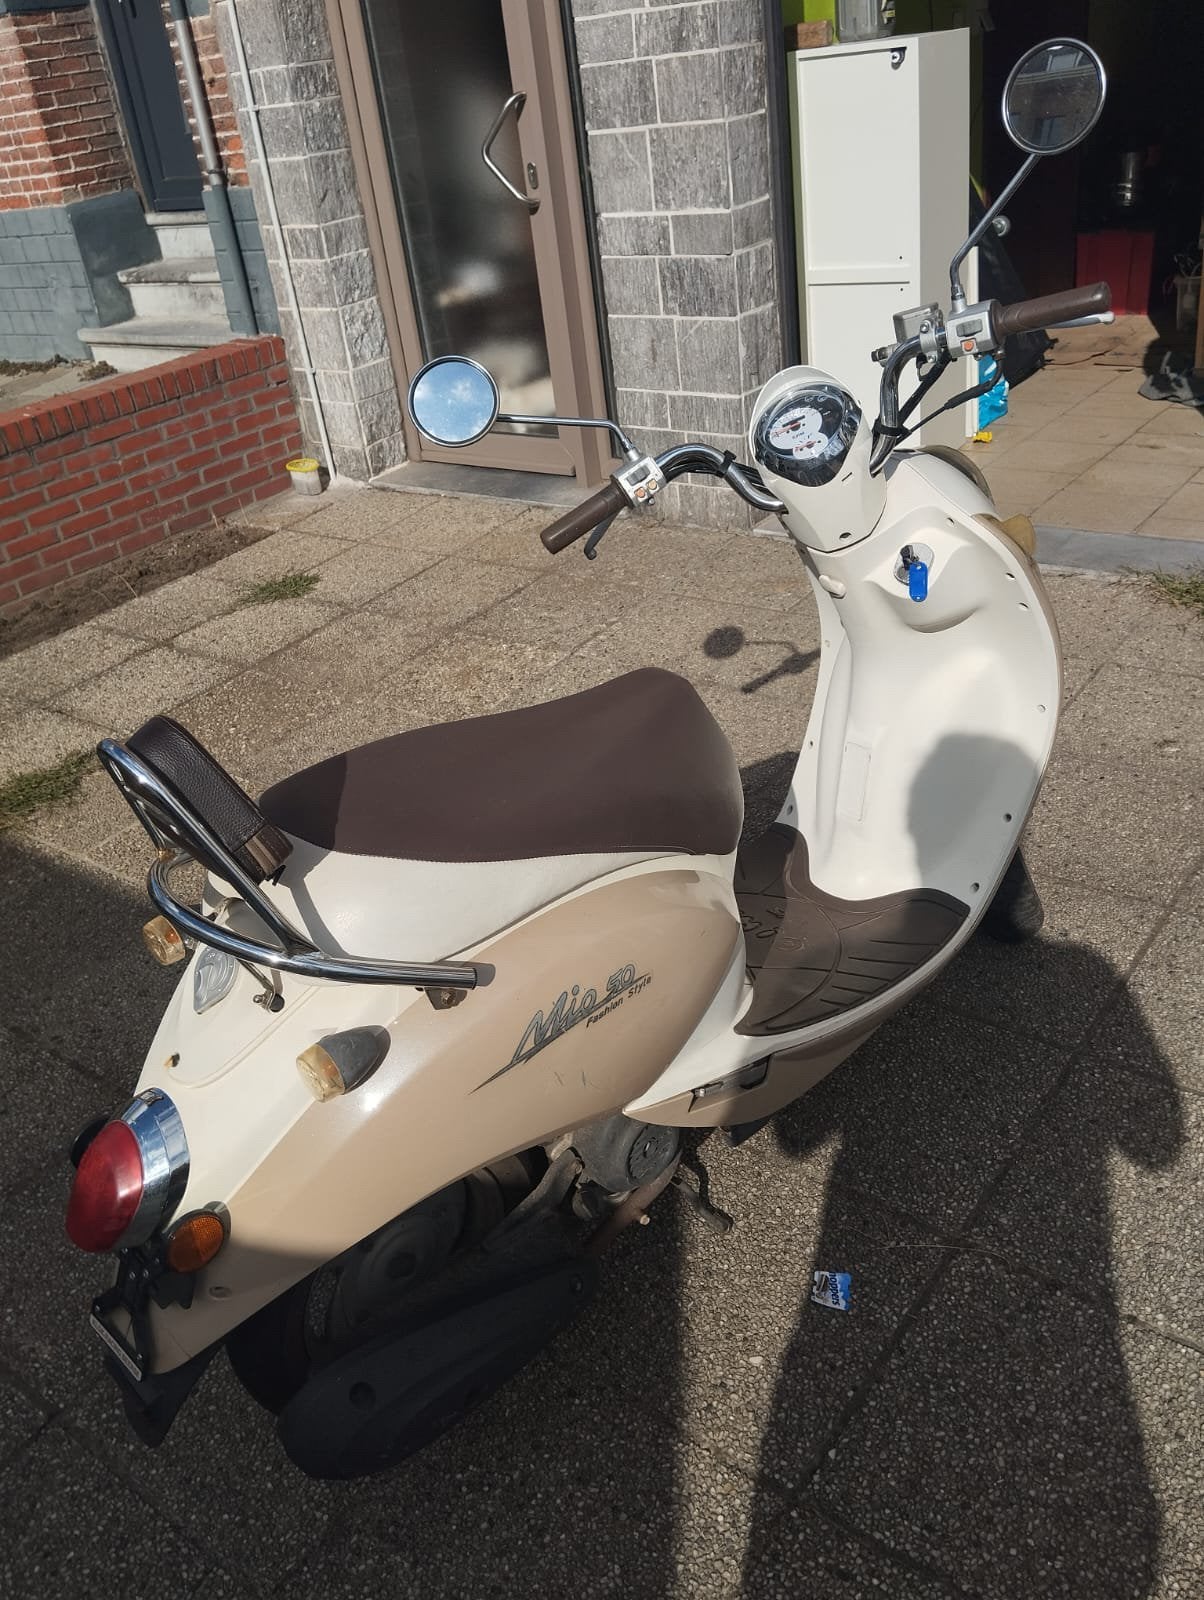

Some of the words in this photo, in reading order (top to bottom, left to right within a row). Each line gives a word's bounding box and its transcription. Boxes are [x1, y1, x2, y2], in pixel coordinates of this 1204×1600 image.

[511, 984, 597, 1065] Mio
[606, 963, 635, 994] 50
[586, 997, 624, 1028] Fashion
[628, 976, 652, 998] Style
